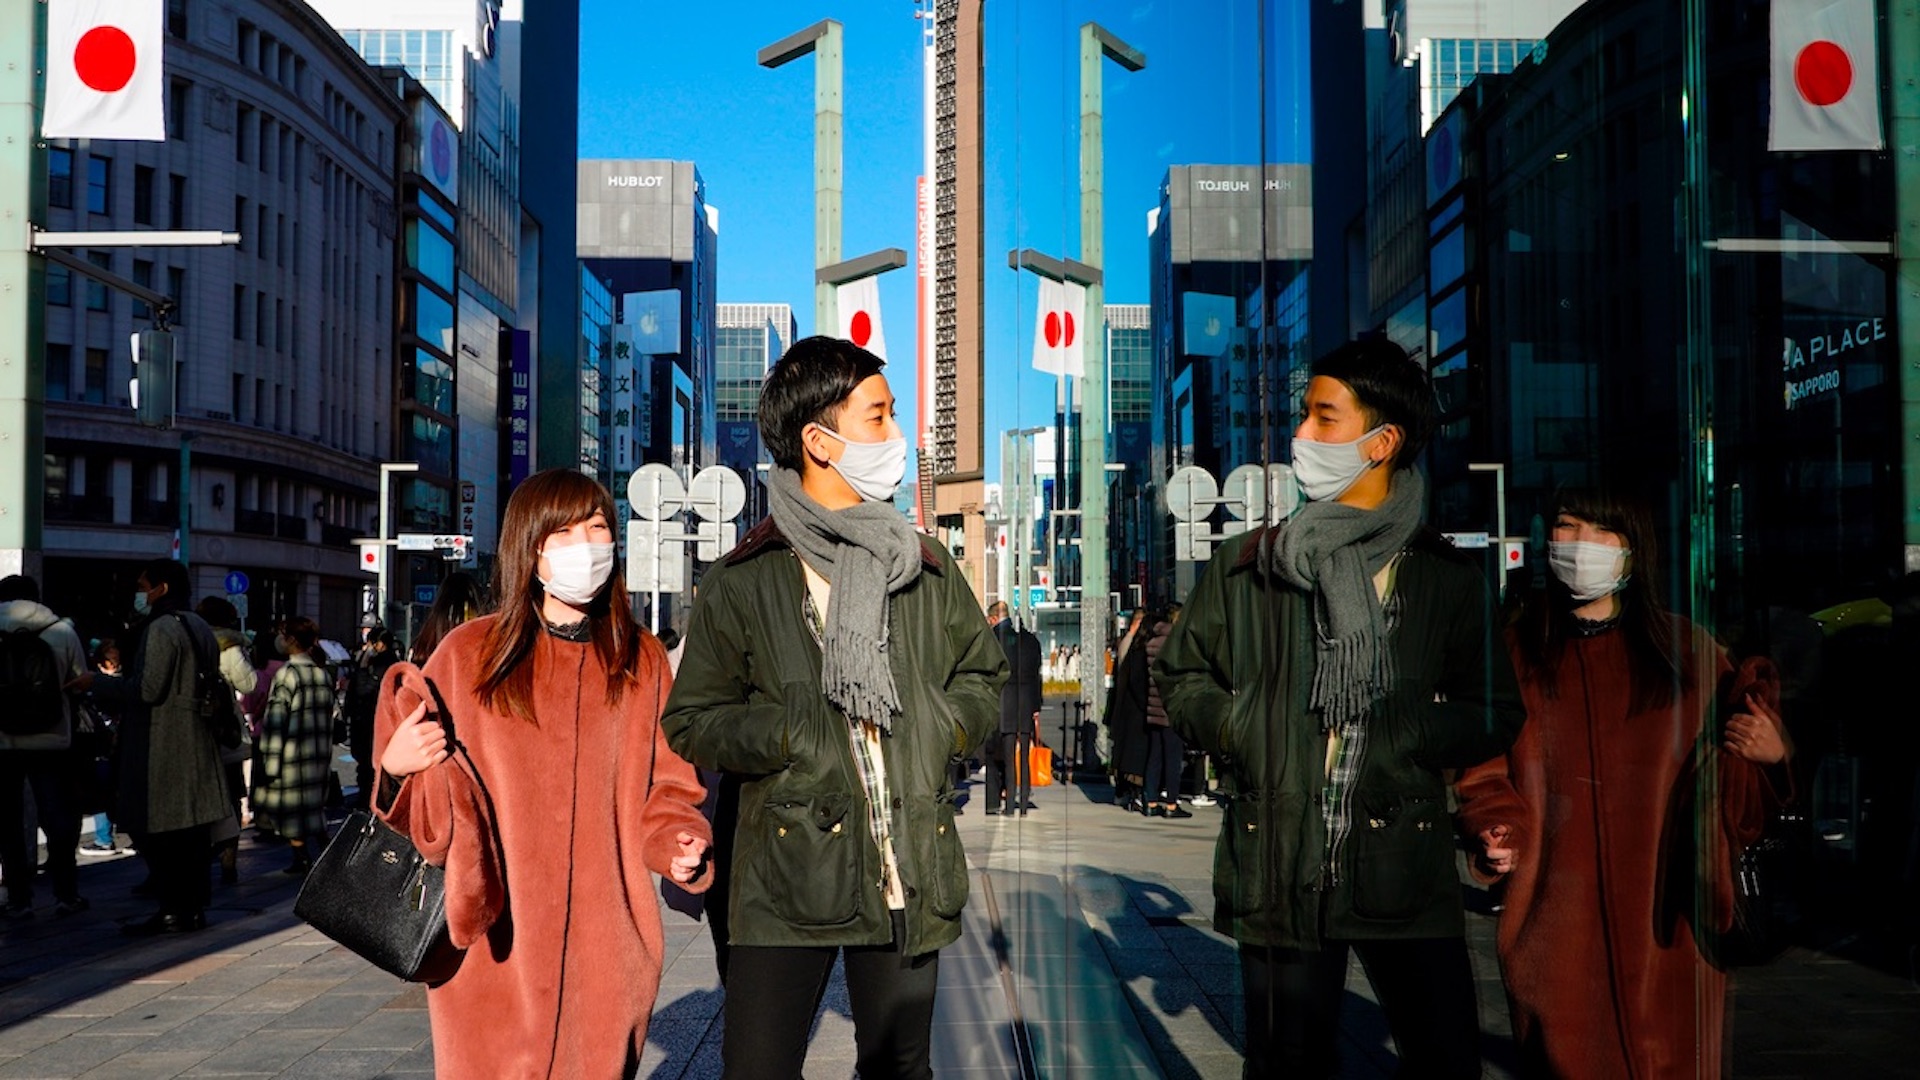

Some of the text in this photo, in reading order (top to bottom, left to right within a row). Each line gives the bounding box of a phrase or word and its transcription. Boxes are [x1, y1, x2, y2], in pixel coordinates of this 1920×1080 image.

[607, 175, 664, 188] HUBLOT
[1810, 318, 1886, 363] PLACE
[1791, 370, 1840, 401] SAPPORO
